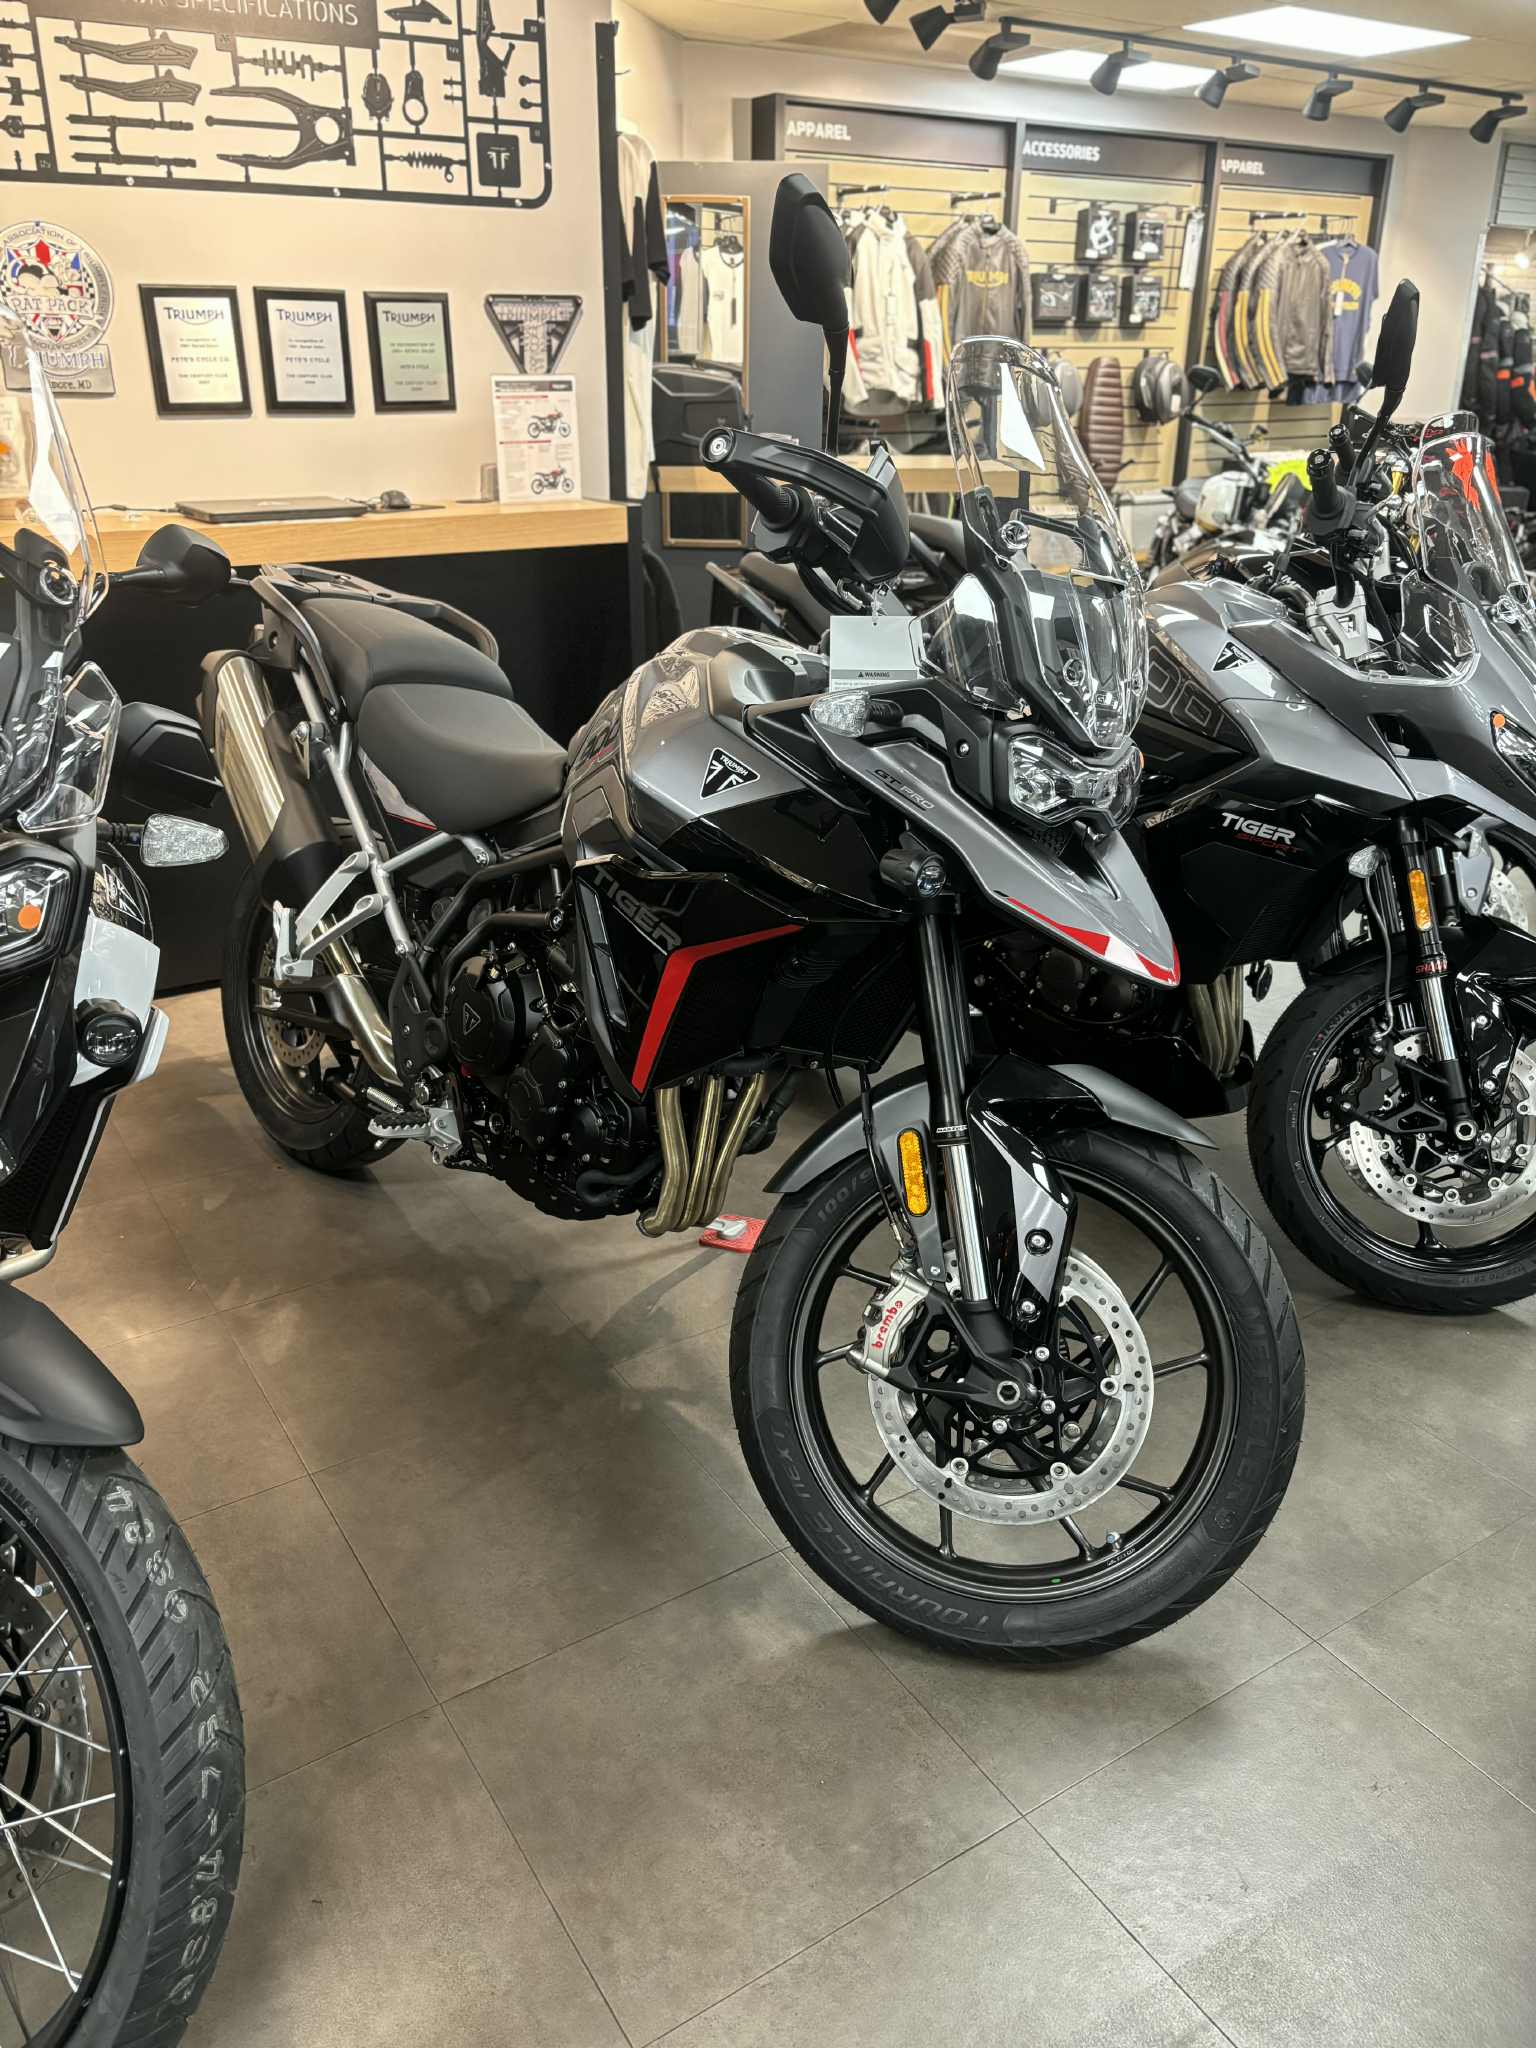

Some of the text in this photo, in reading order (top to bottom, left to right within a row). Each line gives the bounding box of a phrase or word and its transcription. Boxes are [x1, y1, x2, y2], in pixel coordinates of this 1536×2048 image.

[786, 120, 851, 142] APPAREL
[1023, 140, 1101, 163] ACCESSORIES
[10, 298, 91, 315] RAT PACK
[164, 306, 224, 324] TRIUMPH
[276, 308, 333, 326] TRIUMPH
[382, 310, 436, 327] TRIUMPH
[720, 754, 749, 776] TRIUMPH
[875, 769, 935, 809] GT PRO
[1221, 812, 1296, 845] TIGER
[593, 864, 682, 951] TIGER
[816, 1167, 874, 1222] 100/9
[871, 1300, 903, 1348] brembo
